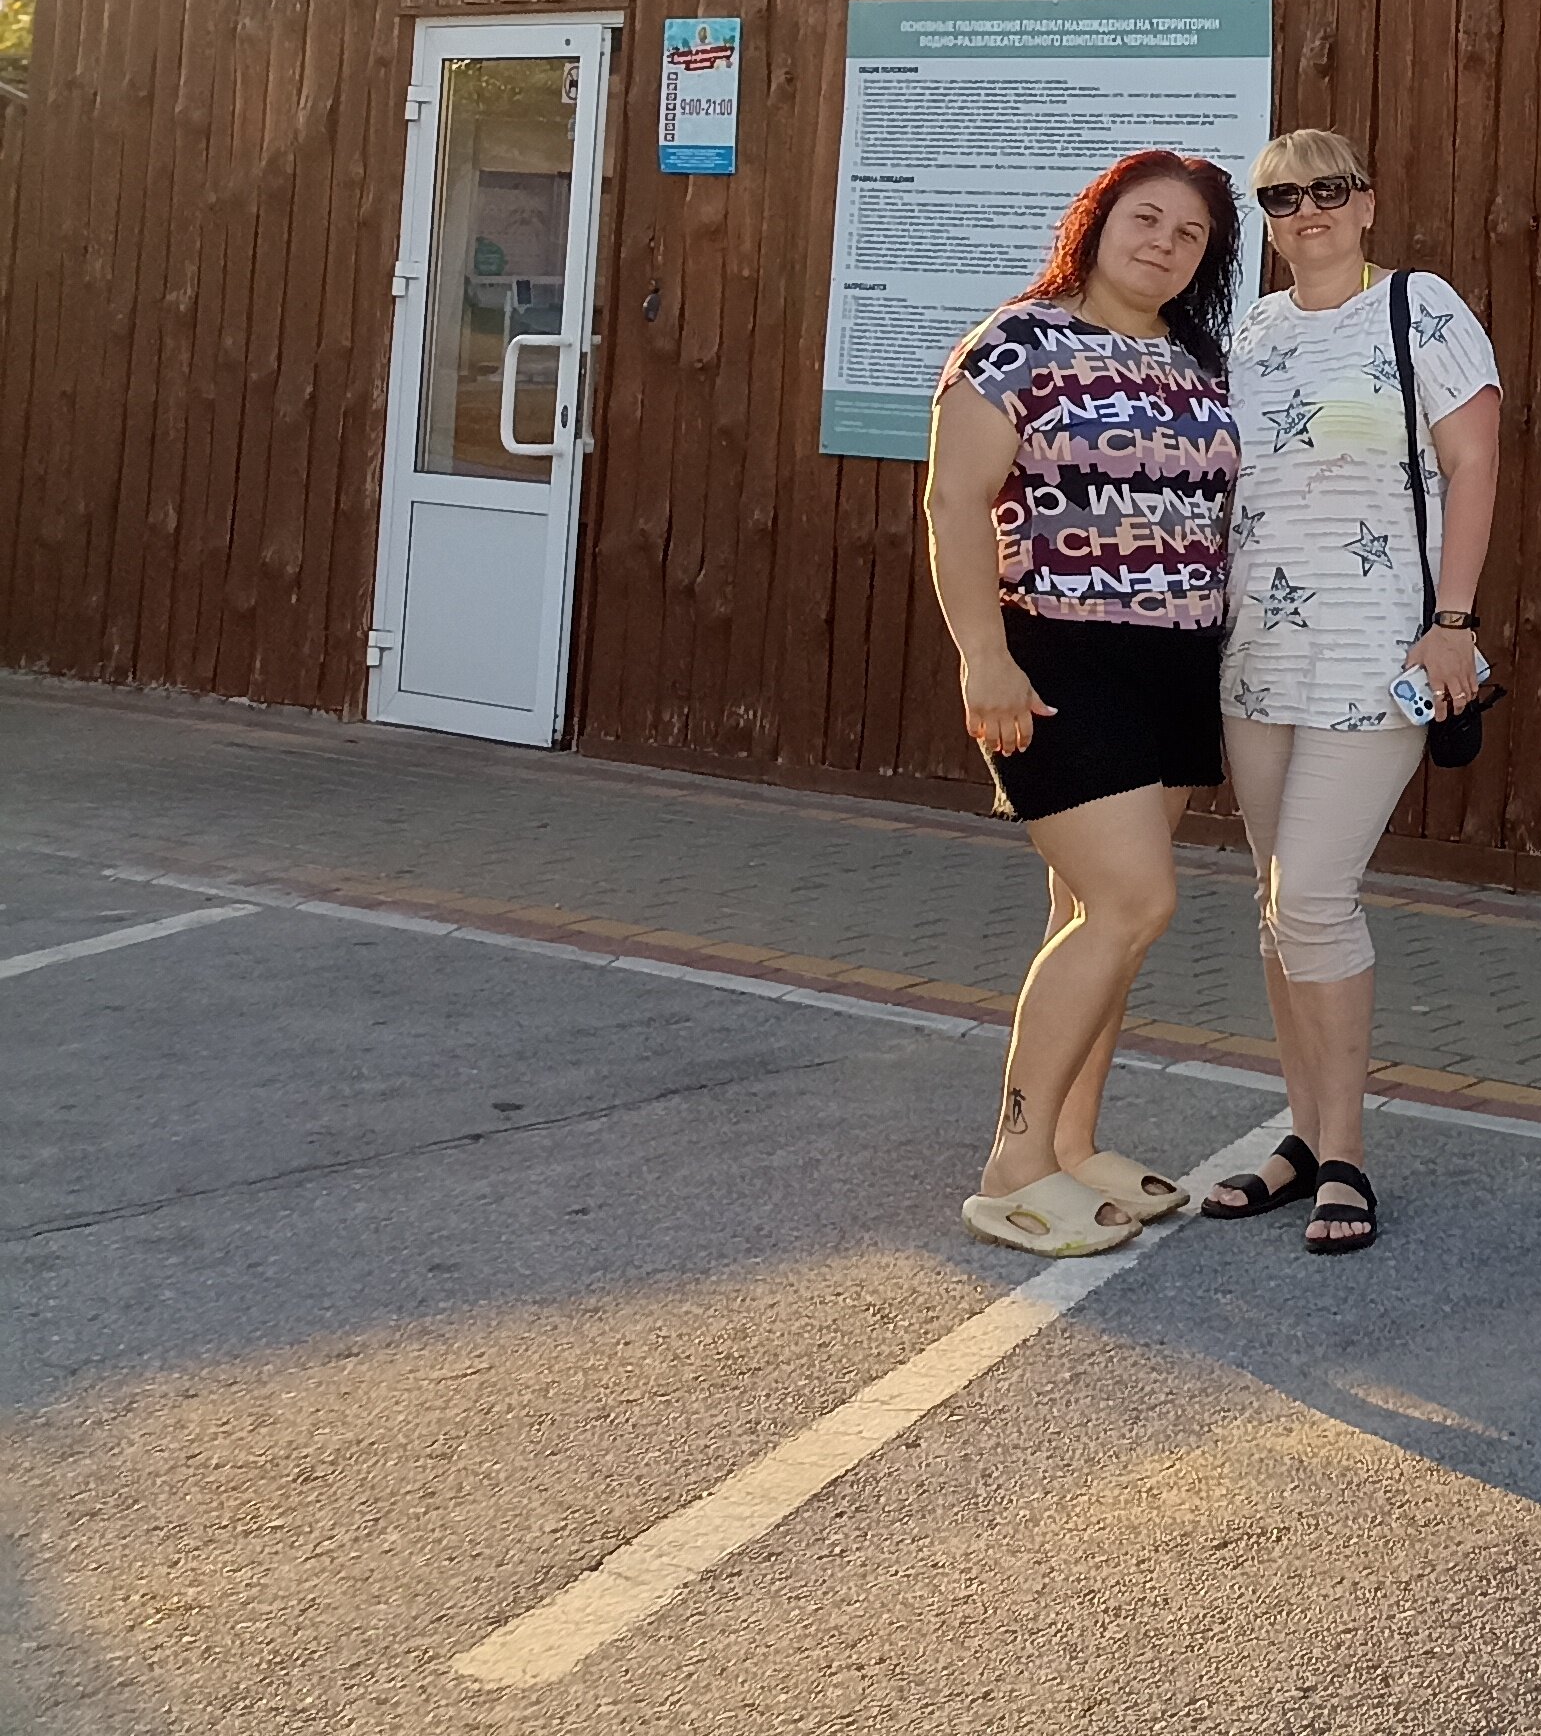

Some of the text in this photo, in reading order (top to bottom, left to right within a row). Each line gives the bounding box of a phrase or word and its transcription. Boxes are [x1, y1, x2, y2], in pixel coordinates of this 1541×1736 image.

[1022, 19, 1063, 31] ПРАВИЛ
[1136, 18, 1151, 31] НА
[1151, 18, 1220, 31] ТЕРРИТОРИИ
